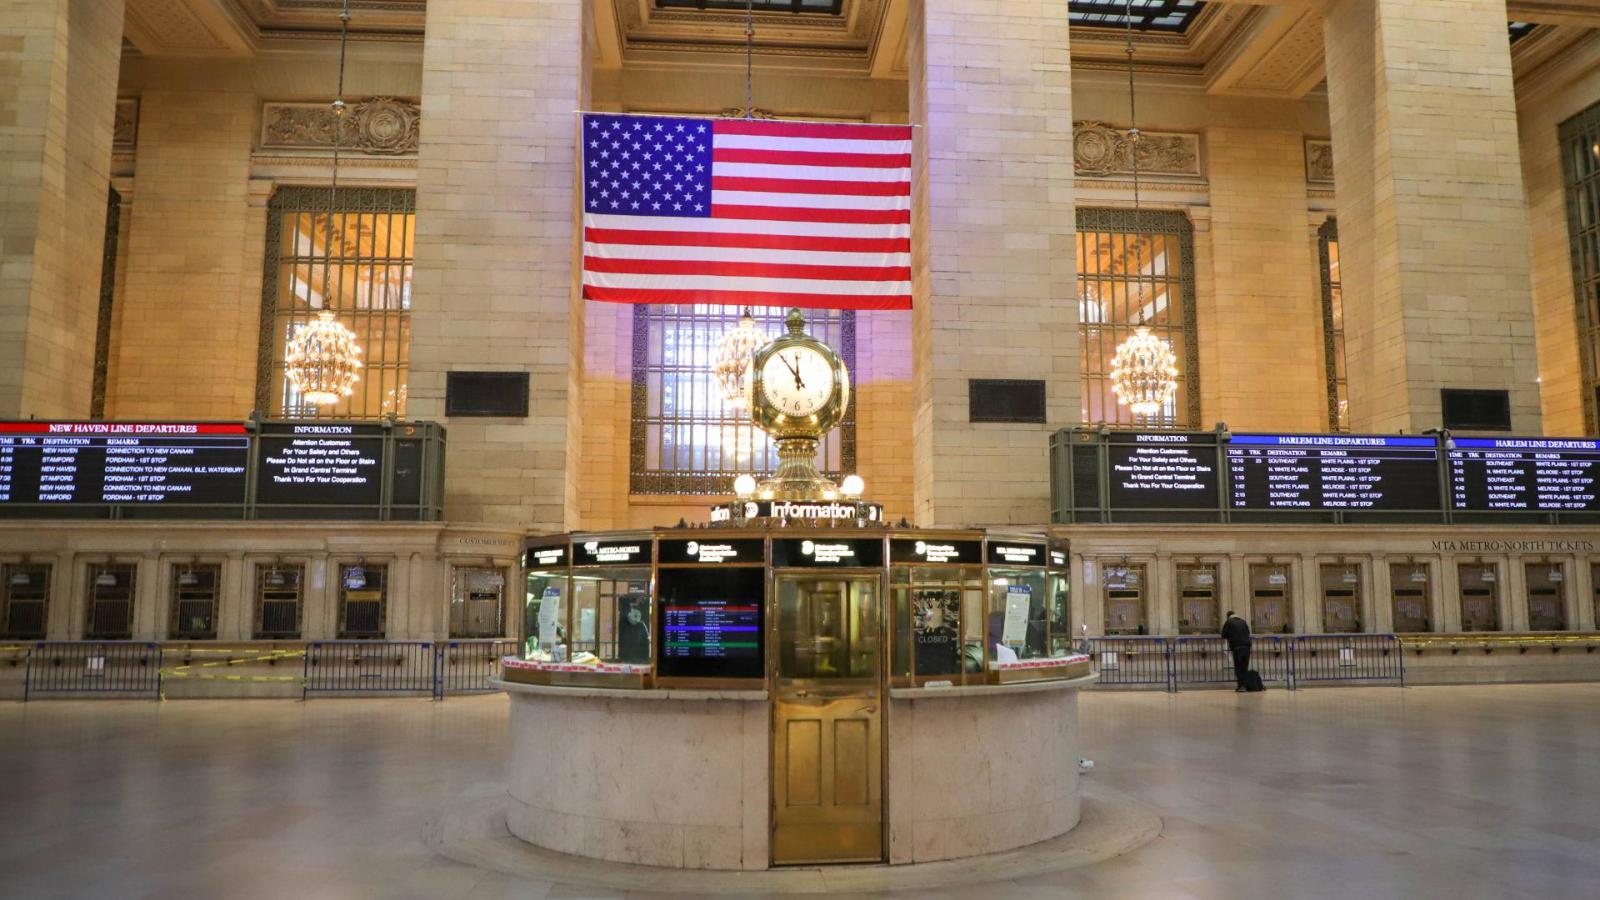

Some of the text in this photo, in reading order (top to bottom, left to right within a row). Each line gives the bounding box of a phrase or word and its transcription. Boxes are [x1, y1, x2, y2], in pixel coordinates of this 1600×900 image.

[782, 398, 789, 406] 7
[795, 401, 800, 410] 6
[49, 424, 72, 432] NEW
[771, 502, 855, 518] Information
[1432, 541, 1593, 551] MTA METRO-NORTH TICKETS
